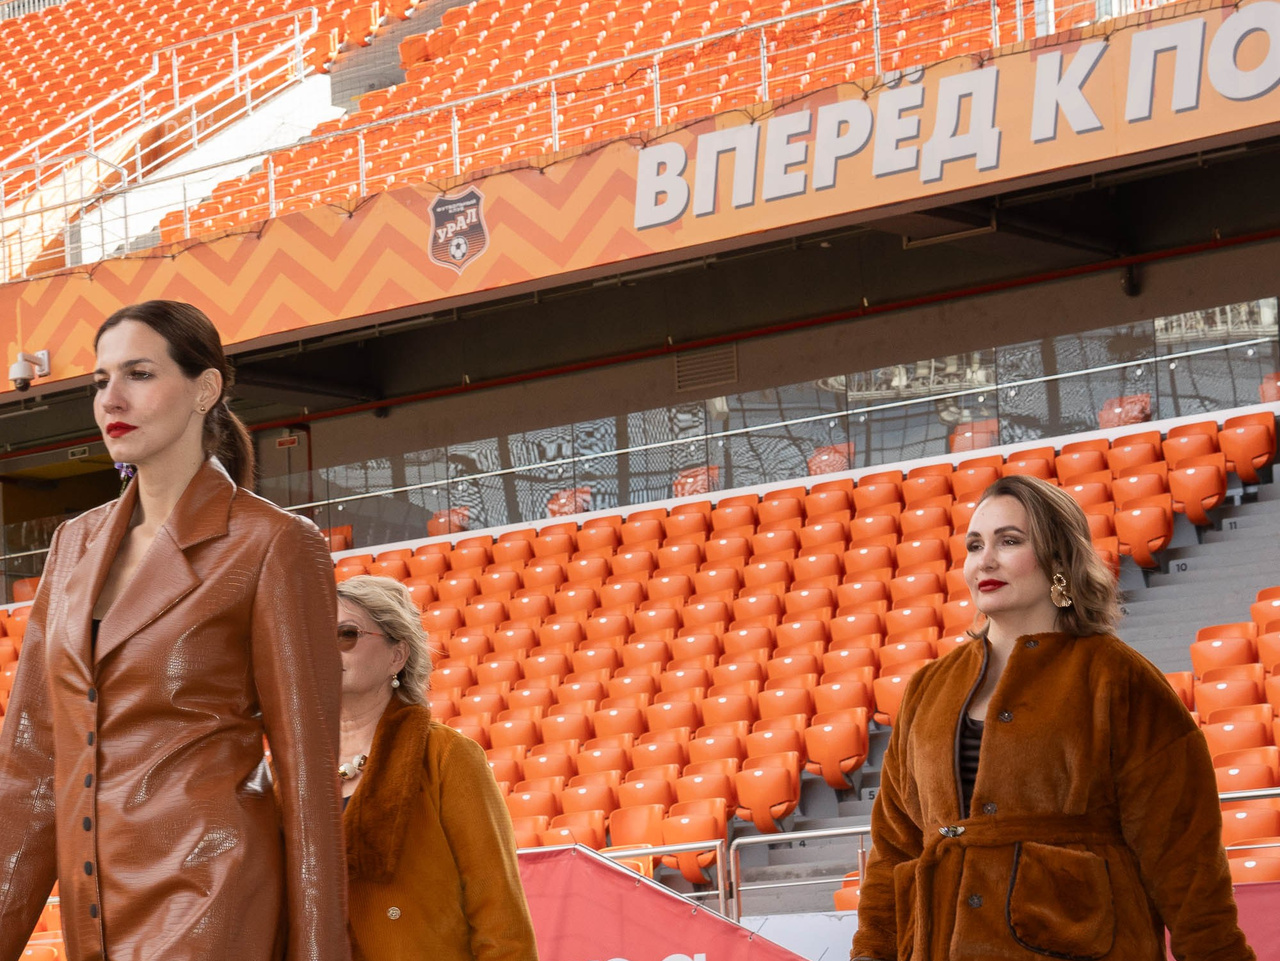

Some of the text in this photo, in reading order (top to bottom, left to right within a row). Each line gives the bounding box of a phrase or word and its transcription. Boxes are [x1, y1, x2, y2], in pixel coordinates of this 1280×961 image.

[633, 0, 1280, 231] ВПЕРЁД К ПО
[1175, 563, 1188, 572] 10
[798, 839, 807, 848] 4
